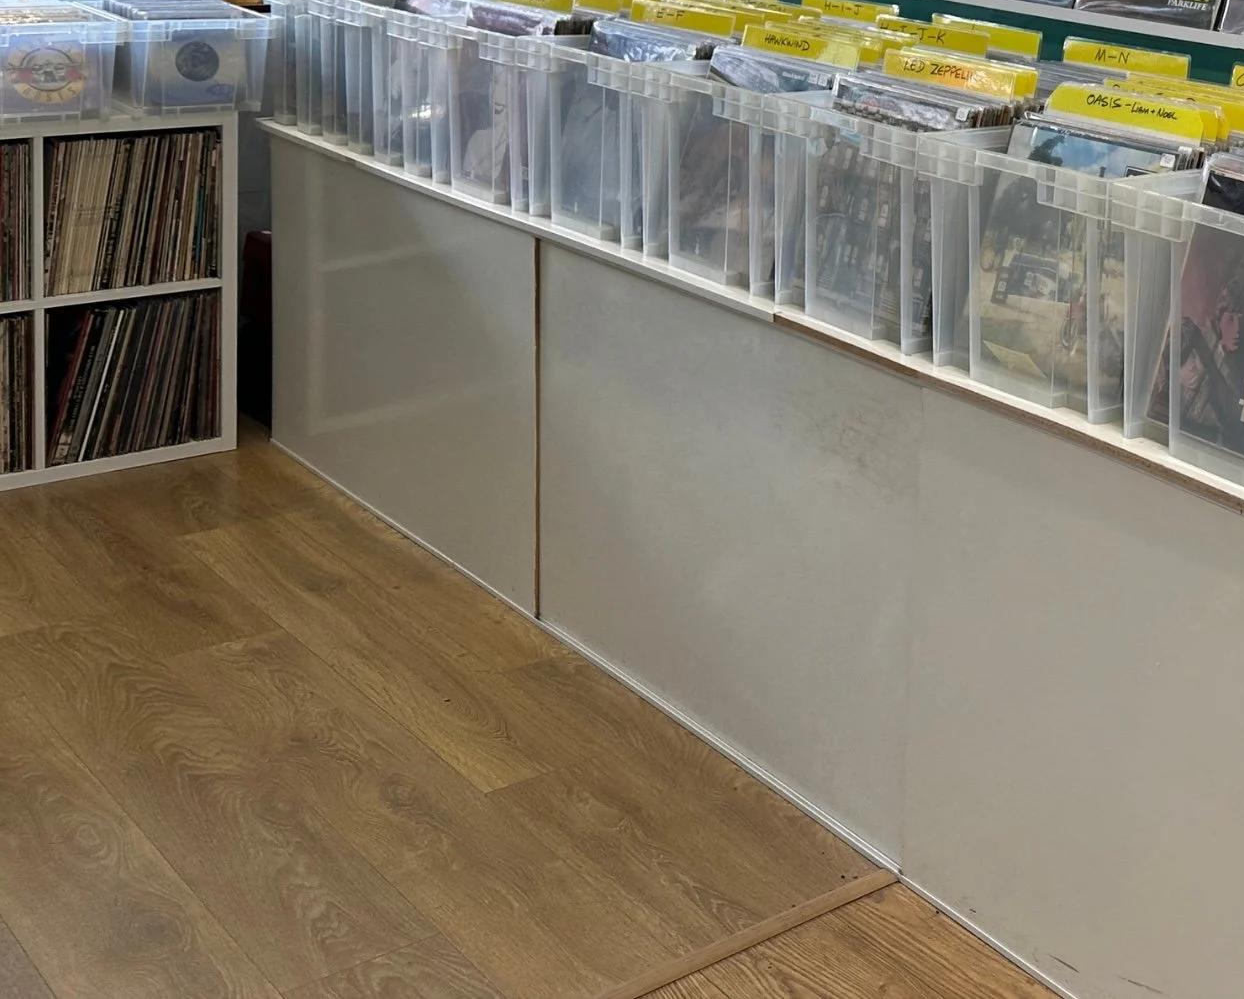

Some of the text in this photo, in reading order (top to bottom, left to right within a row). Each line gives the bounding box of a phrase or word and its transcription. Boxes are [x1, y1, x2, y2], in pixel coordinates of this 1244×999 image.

[764, 33, 811, 52] HAWKWIND
[903, 59, 925, 73] LED
[1086, 93, 1122, 108] OASIS
